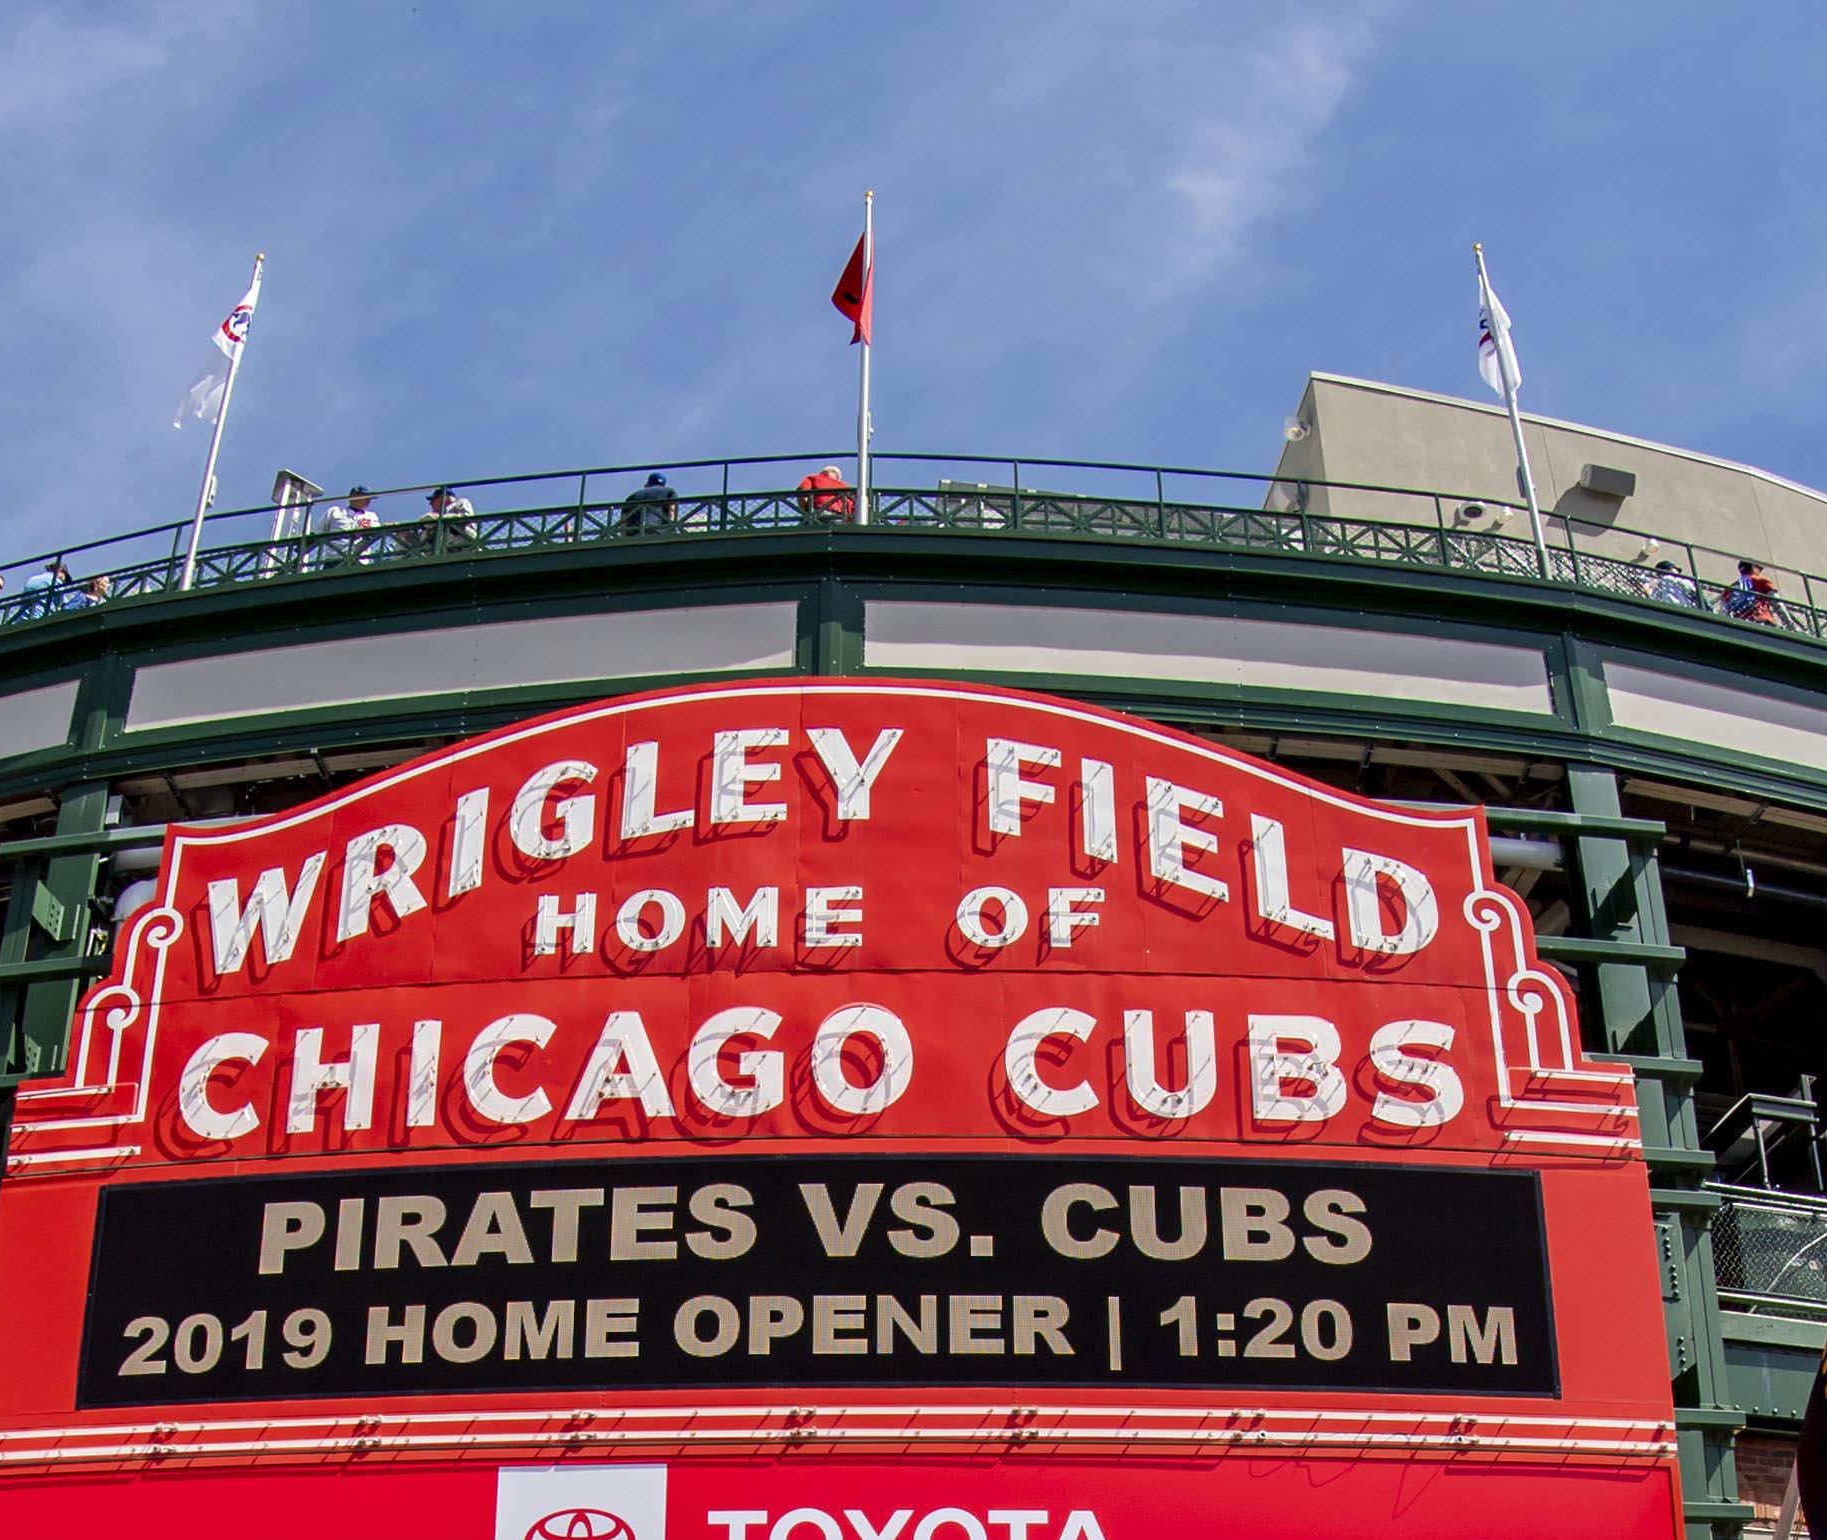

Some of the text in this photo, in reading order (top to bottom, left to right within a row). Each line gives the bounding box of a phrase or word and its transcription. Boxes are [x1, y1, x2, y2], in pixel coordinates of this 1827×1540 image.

[207, 727, 1439, 974] WRIGLEY FIELD
[536, 885, 1105, 955] HOME OF
[178, 1003, 1465, 1141] CHICAGO CUBS
[258, 1181, 1373, 1275] PIRATES VS. CUBS
[117, 1294, 1518, 1376] 2019 HOME OPENER 1:20 PM
